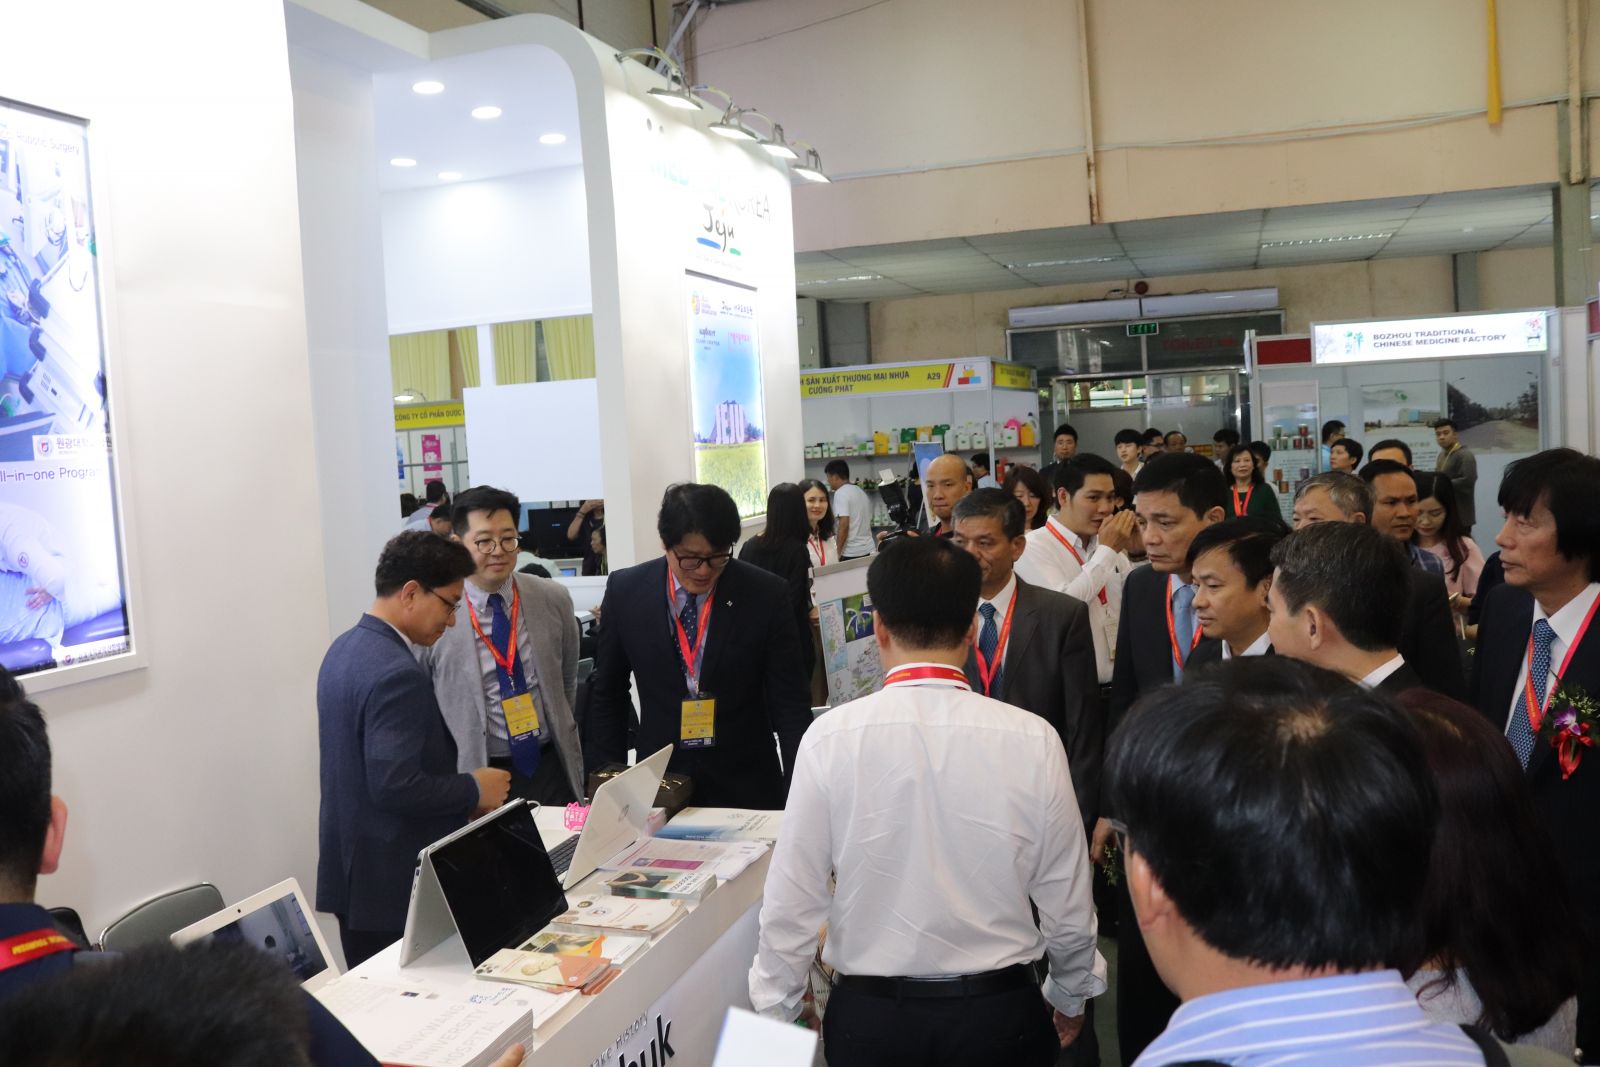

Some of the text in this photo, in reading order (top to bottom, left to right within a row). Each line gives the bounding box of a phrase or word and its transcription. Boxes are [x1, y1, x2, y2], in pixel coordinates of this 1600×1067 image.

[1373, 328, 1476, 340] BOZHOU TRADITIONAL
[1373, 334, 1507, 348] CHINESE MEDICINE FACTORY
[928, 372, 941, 380] A29
[716, 402, 745, 444] JEJU
[615, 1009, 649, 1049] History
